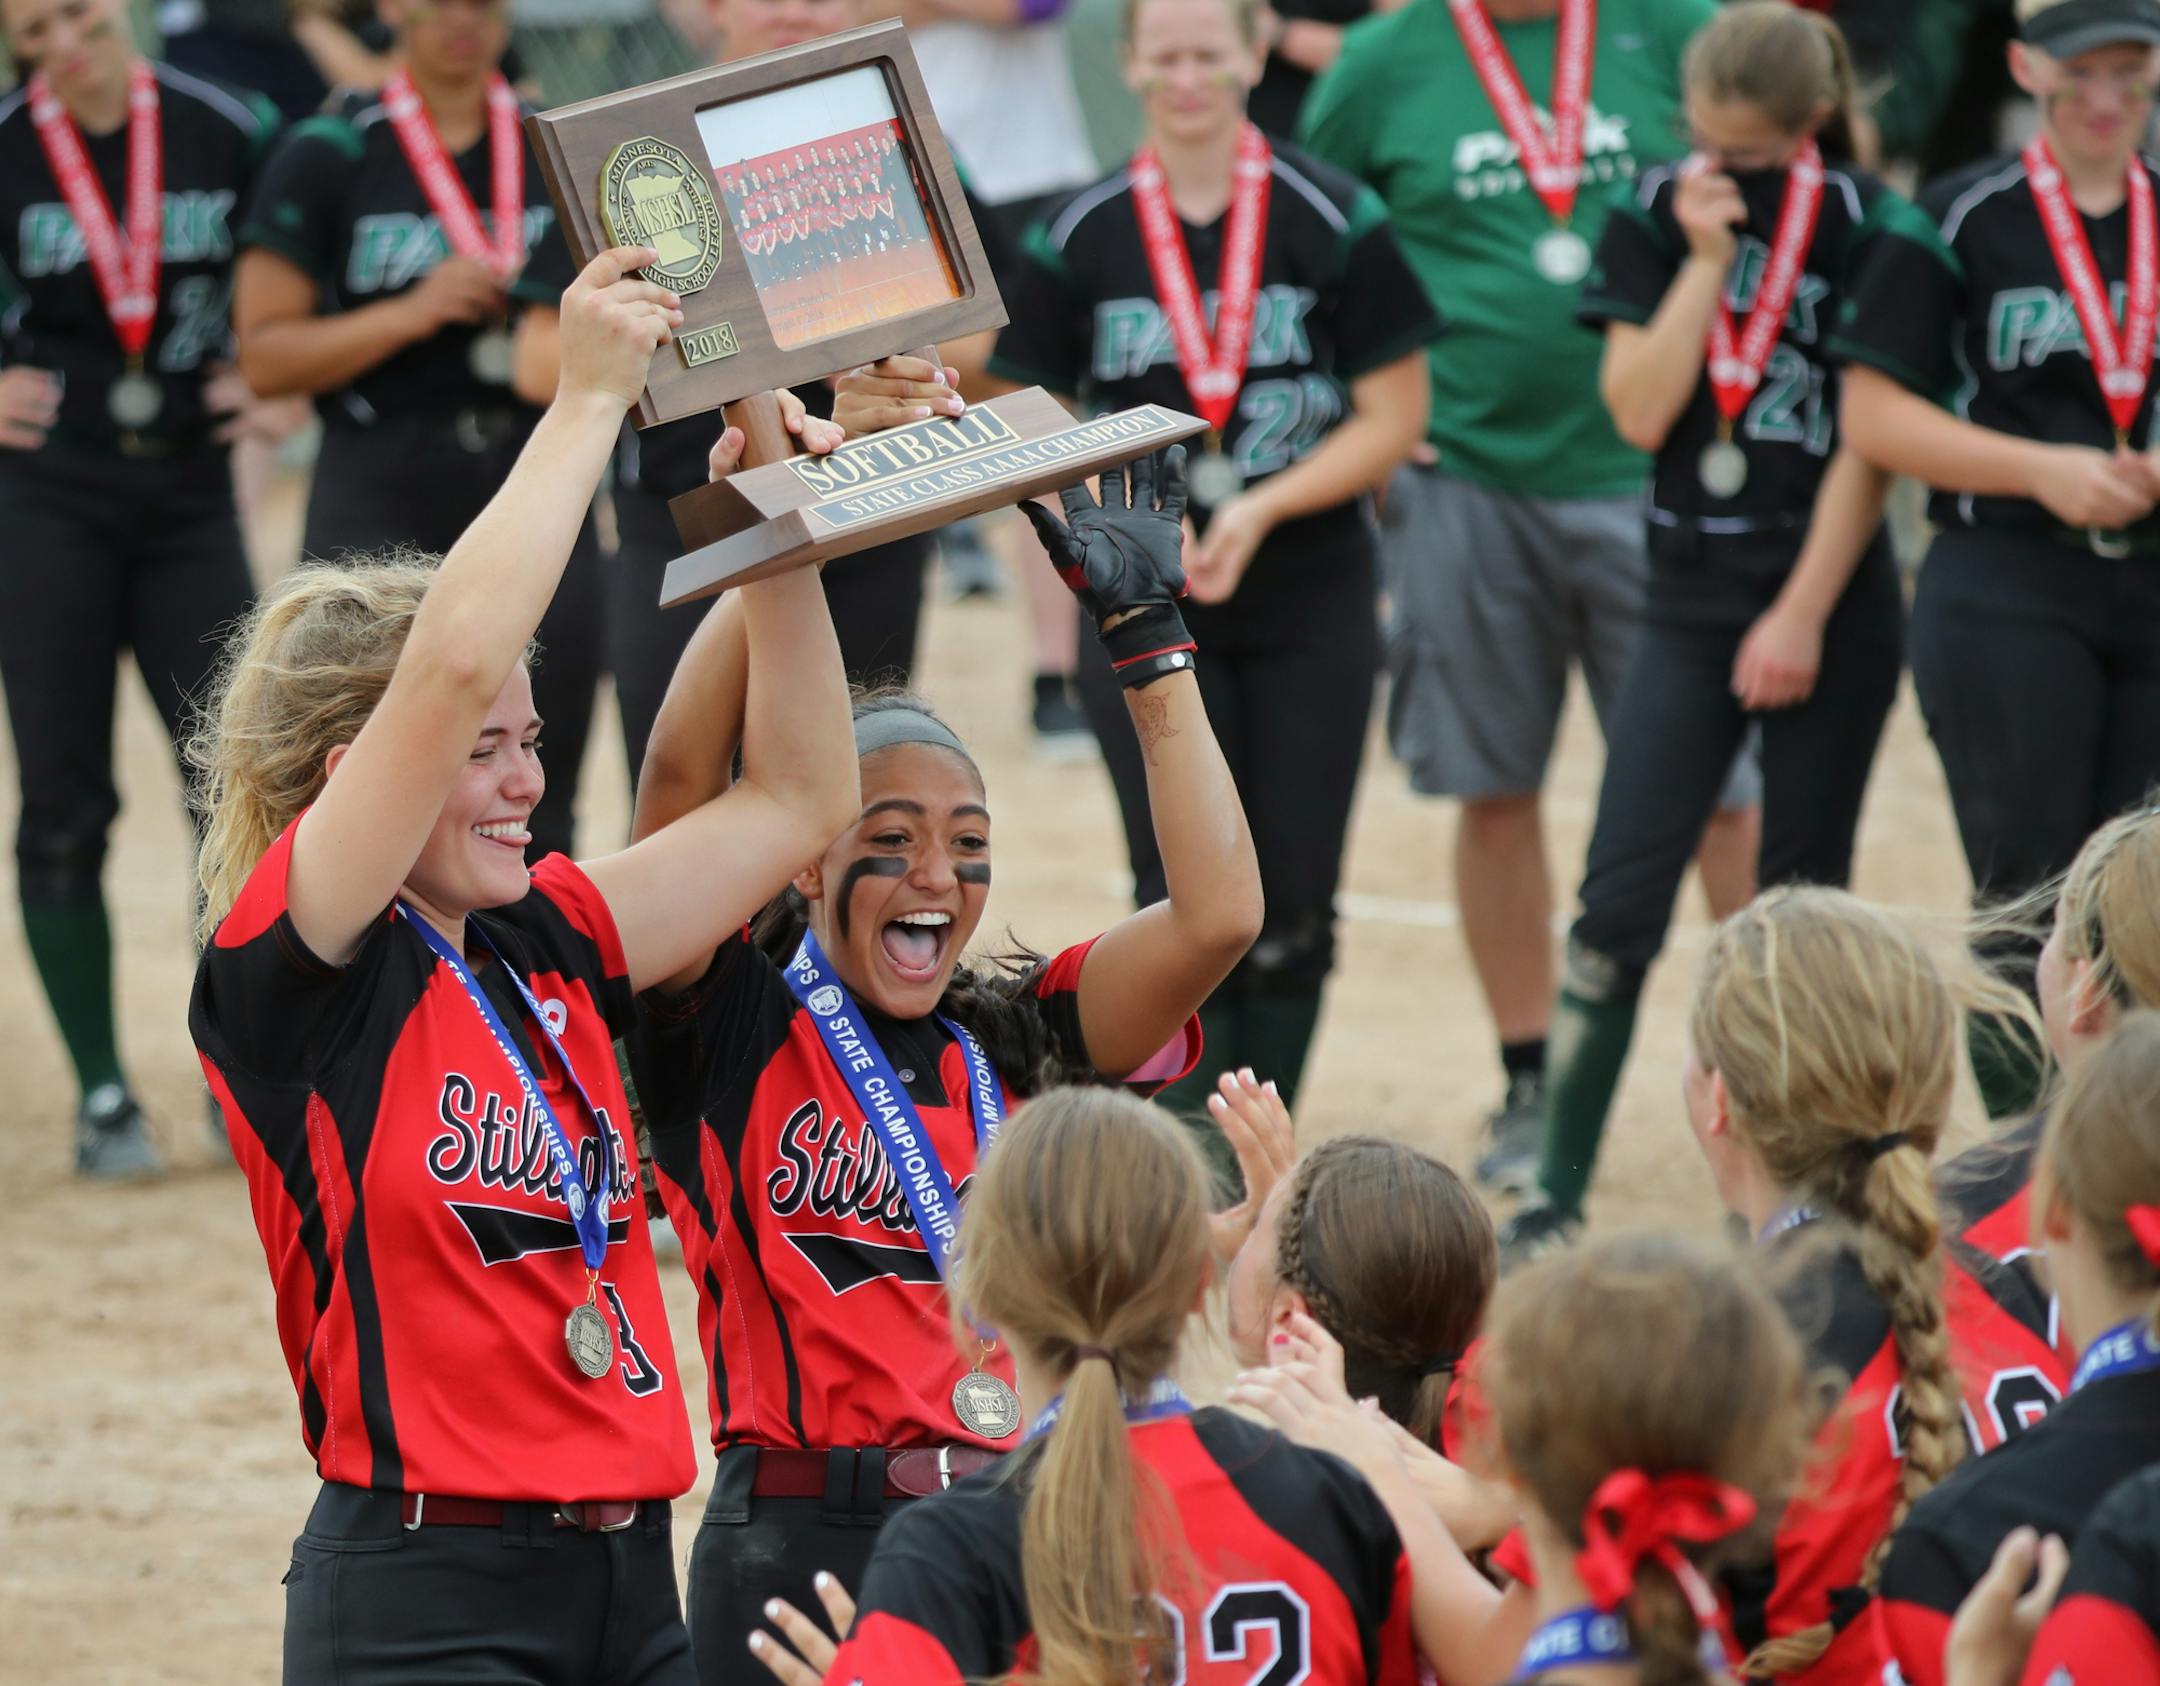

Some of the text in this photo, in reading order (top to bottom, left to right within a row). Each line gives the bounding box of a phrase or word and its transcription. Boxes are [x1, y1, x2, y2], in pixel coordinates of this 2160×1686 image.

[611, 144, 681, 184] MINNESOTA
[18, 189, 237, 279] PRK
[631, 191, 697, 238] MSHSL
[644, 265, 676, 290] HIGH
[677, 260, 717, 291] SCHOOL
[702, 193, 720, 258] LEAGUE
[687, 328, 733, 361] 2018
[797, 412, 1012, 493] SOFTBALL
[841, 413, 1159, 516] STATE CLASS AAAA CHAMPION
[829, 1016, 875, 1073] STATE
[953, 1021, 1001, 1148] AMPIONS
[470, 995, 574, 1176] CMPIONSHIPS
[969, 1398, 1005, 1412] MSHSL
